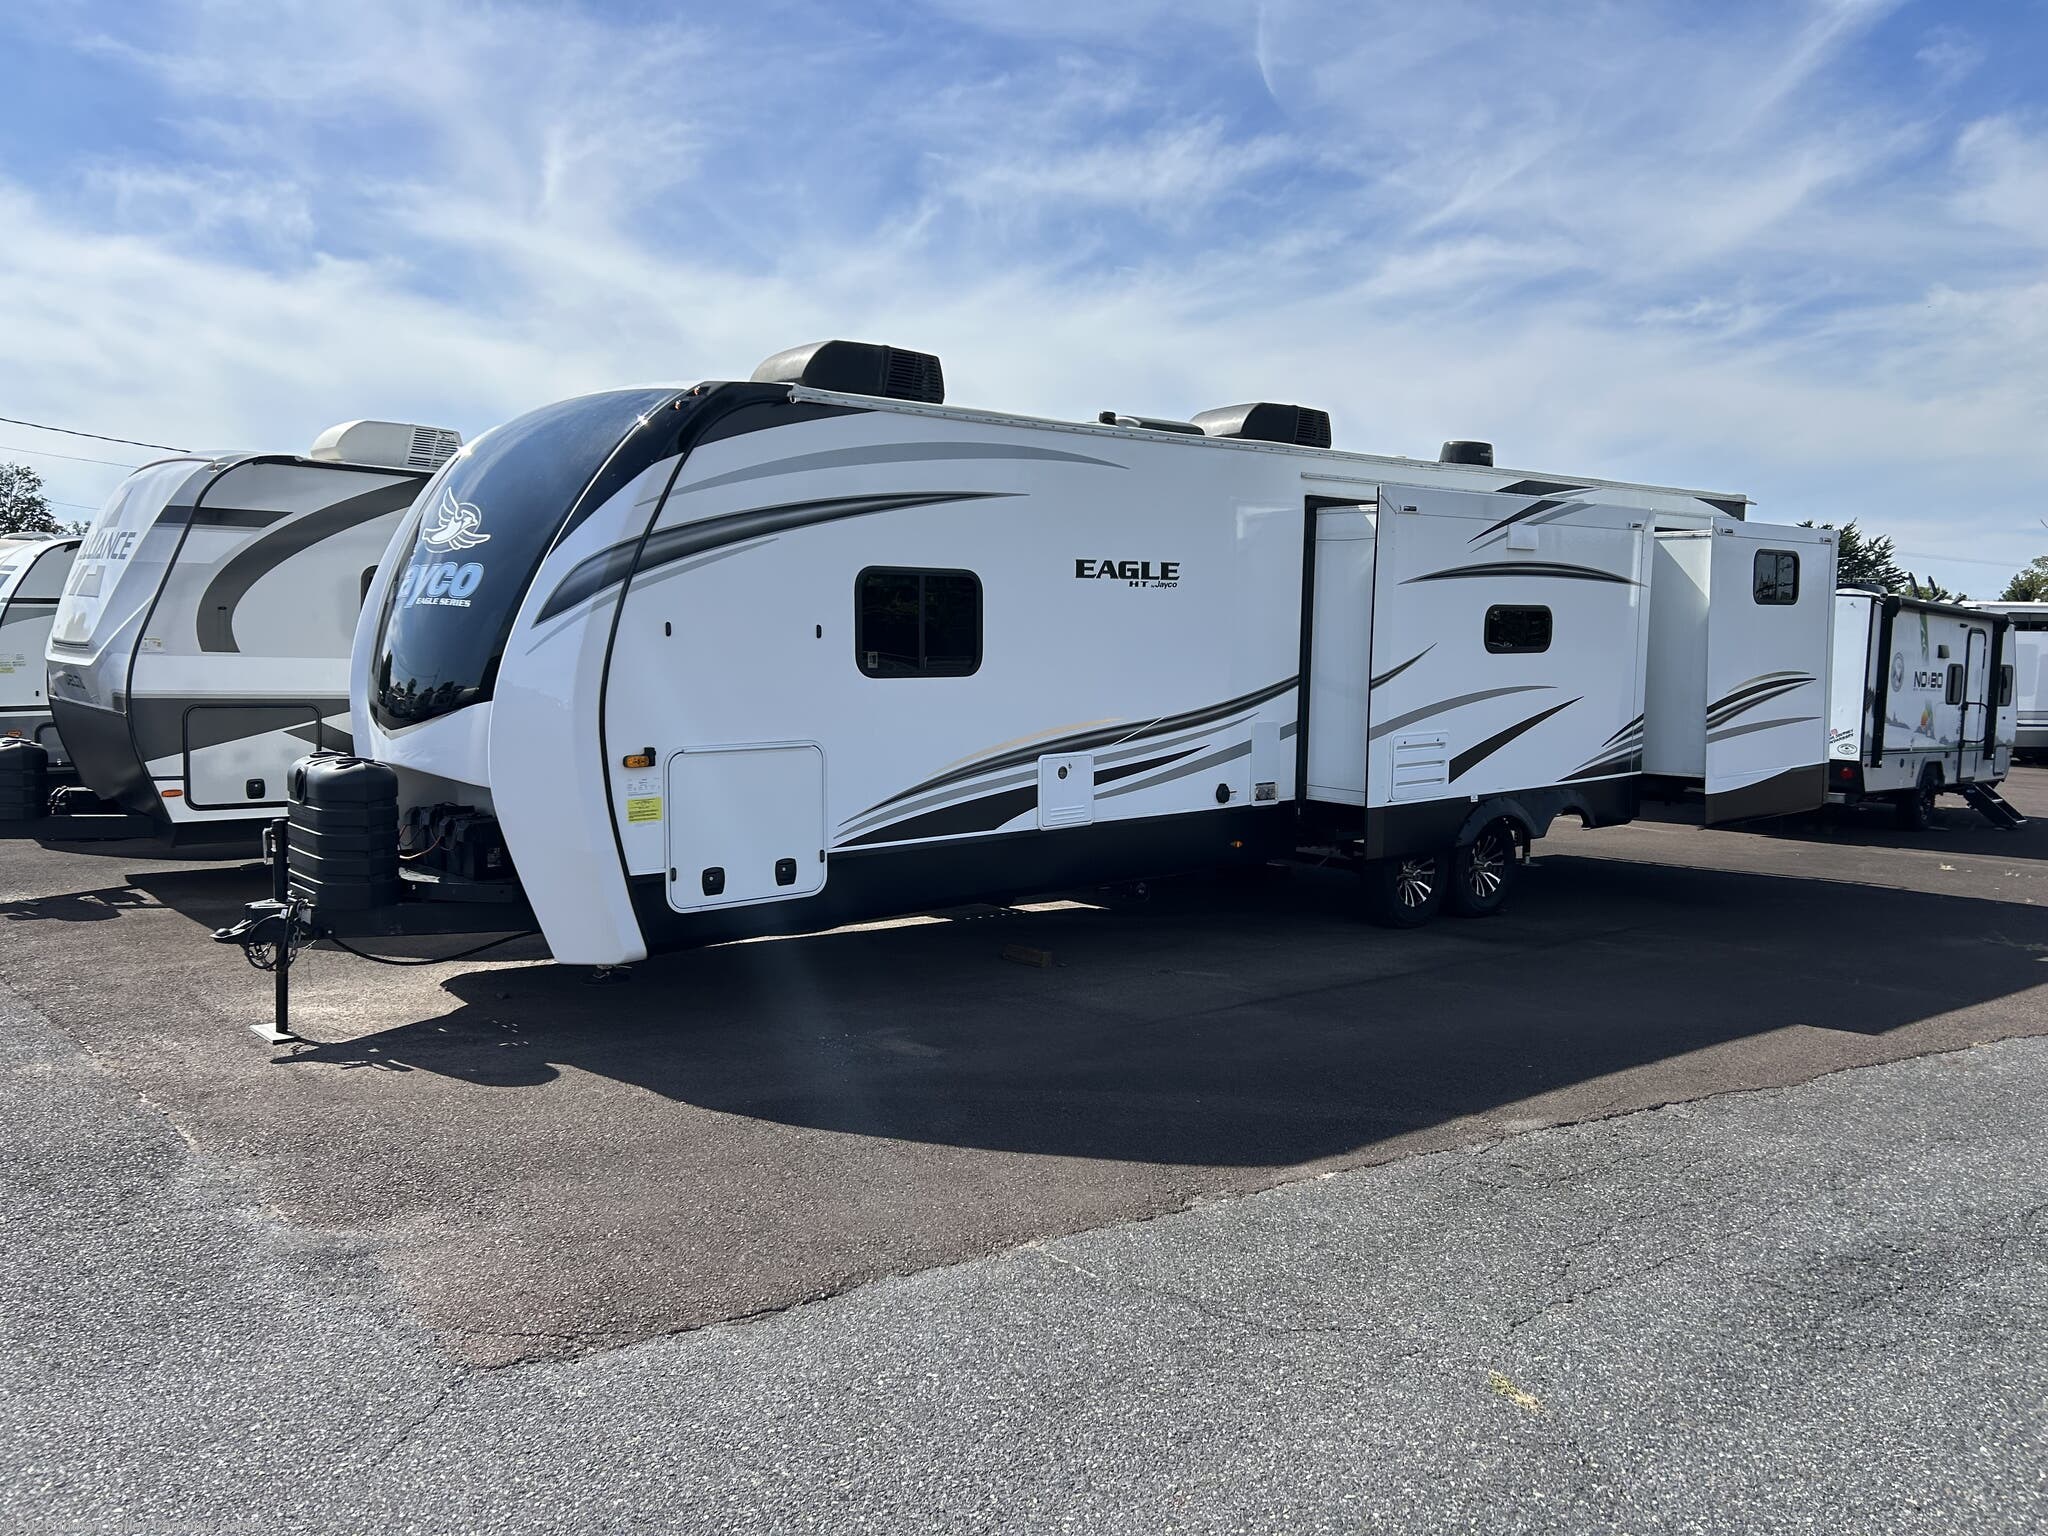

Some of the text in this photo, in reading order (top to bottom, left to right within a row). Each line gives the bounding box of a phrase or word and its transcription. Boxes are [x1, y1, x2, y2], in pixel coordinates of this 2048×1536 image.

[1075, 559, 1180, 581] EAGLE
[397, 562, 484, 608] ayco
[1129, 580, 1148, 588] HT
[1155, 580, 1178, 590] Jayco
[416, 597, 472, 607] EAGLE SERIES
